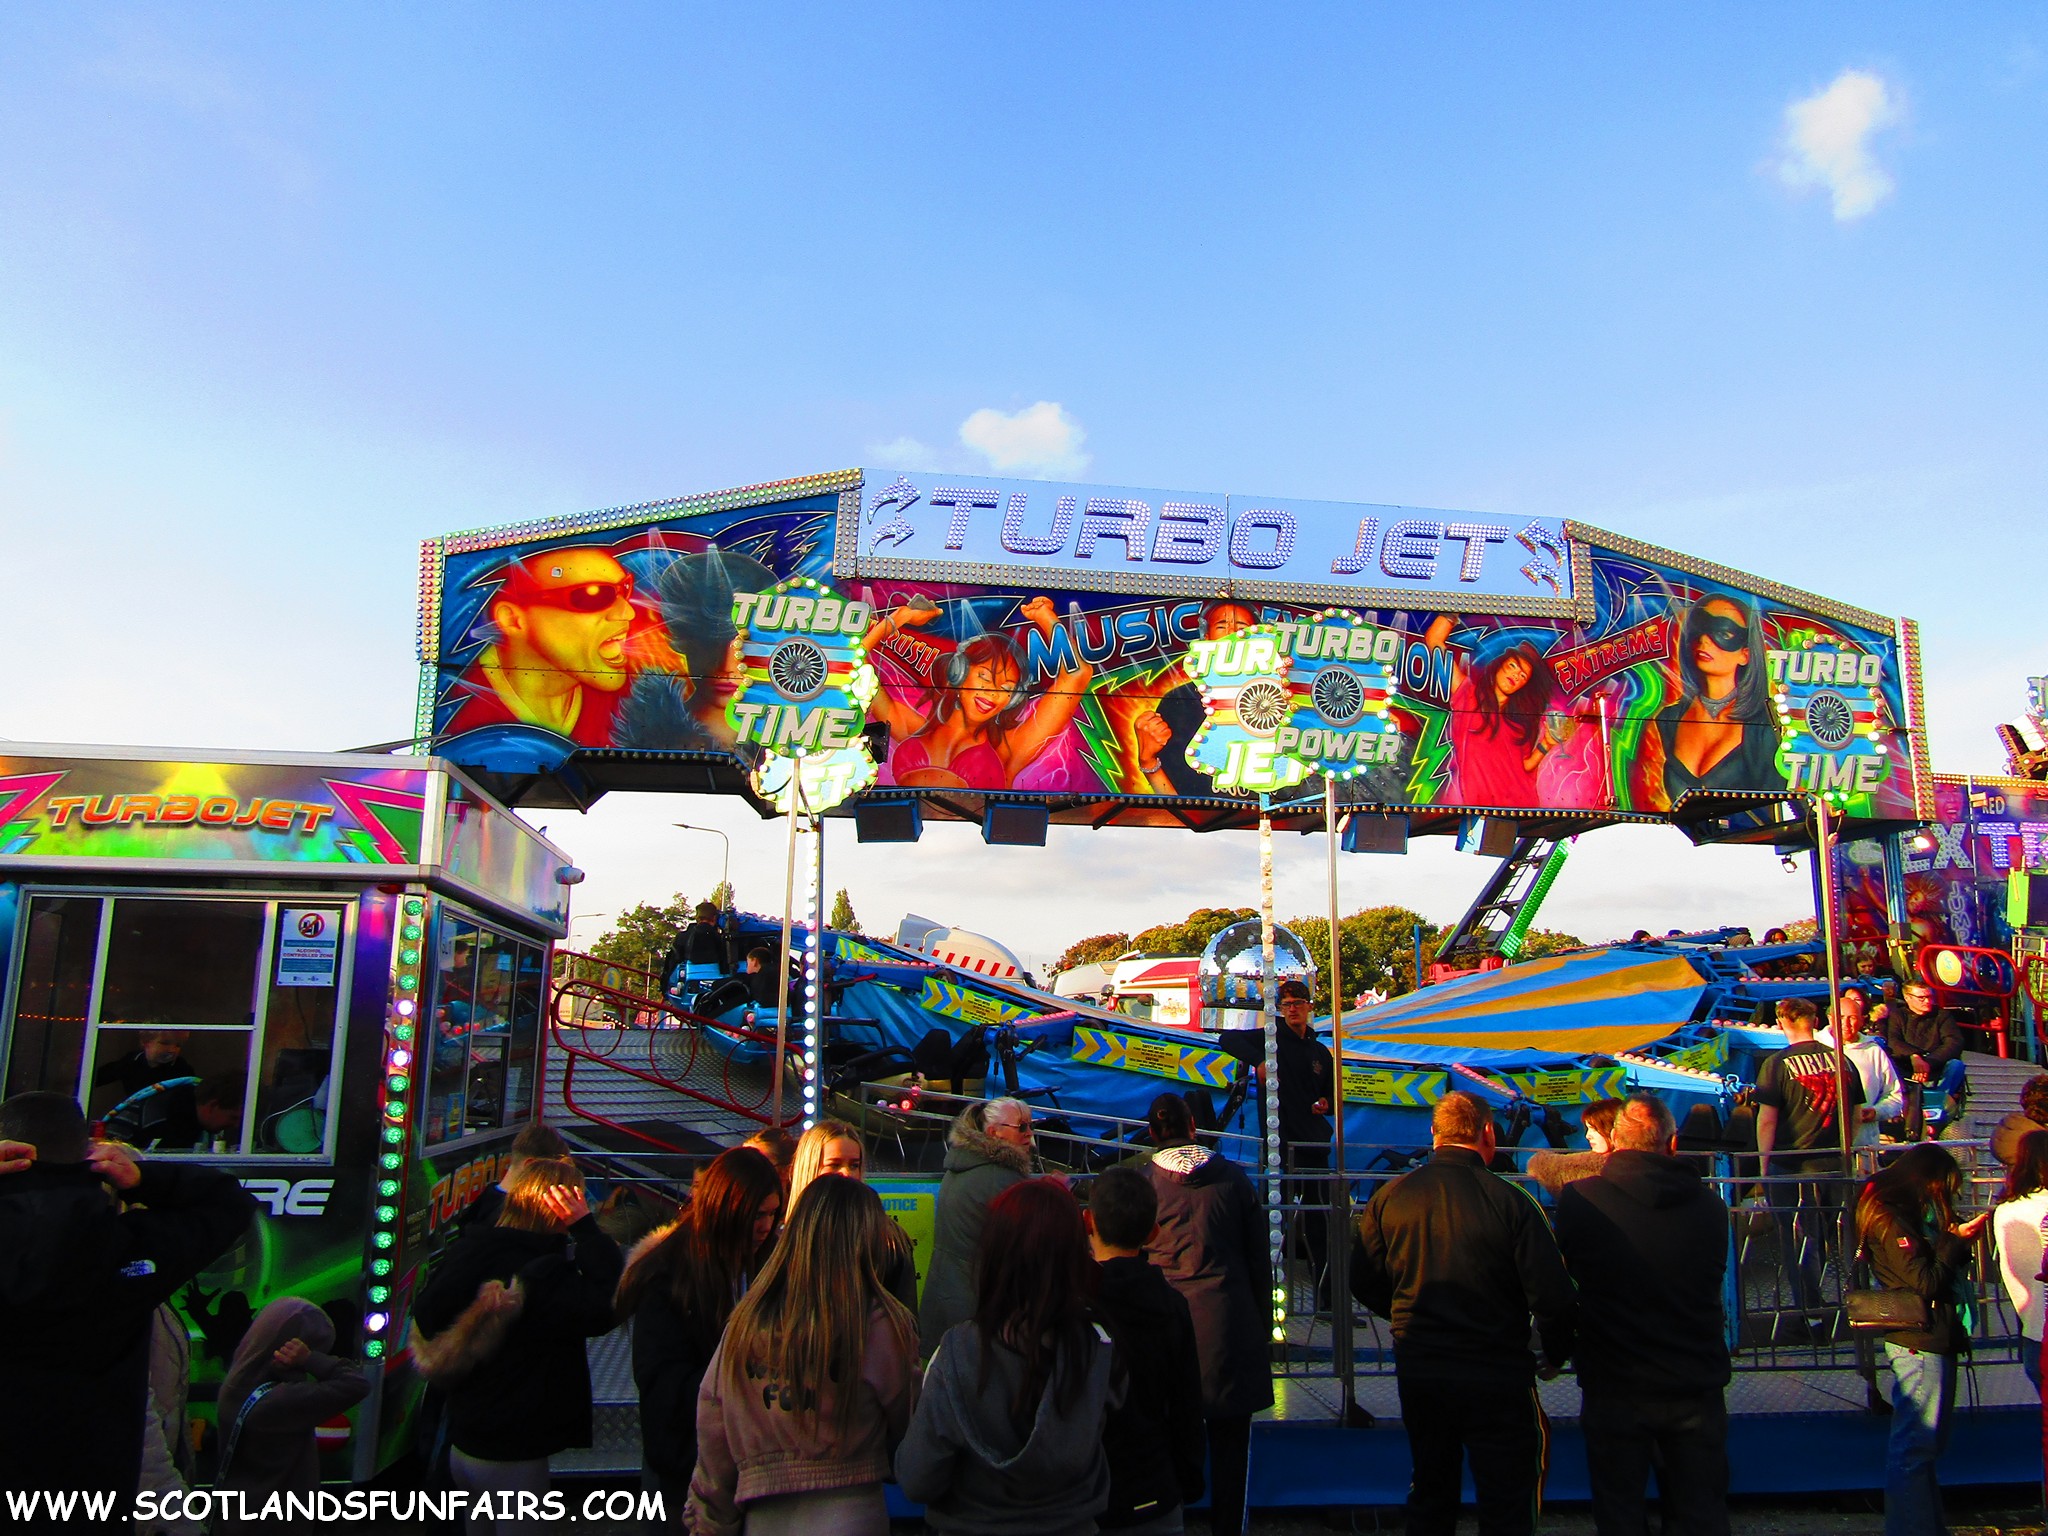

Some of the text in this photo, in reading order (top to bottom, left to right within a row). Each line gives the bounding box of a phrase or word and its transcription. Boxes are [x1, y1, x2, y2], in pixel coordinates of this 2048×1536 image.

[930, 487, 1510, 582] TURBO JET
[733, 592, 872, 636] TURBO
[880, 628, 941, 677] RUSH
[1027, 601, 1204, 684] MUSIC
[1193, 638, 1285, 677] TUR
[1275, 621, 1400, 663] TURBO
[1554, 624, 1663, 695] EXTREME
[1766, 650, 1882, 685] TURBO
[734, 702, 858, 750] TIME
[1274, 727, 1400, 764] POWER
[1783, 752, 1884, 794] TIME
[49, 793, 335, 832] TURBOJET
[1783, 1051, 1853, 1080] NIRVA
[239, 1179, 335, 1215] RE
[881, 1198, 918, 1211] OTICE
